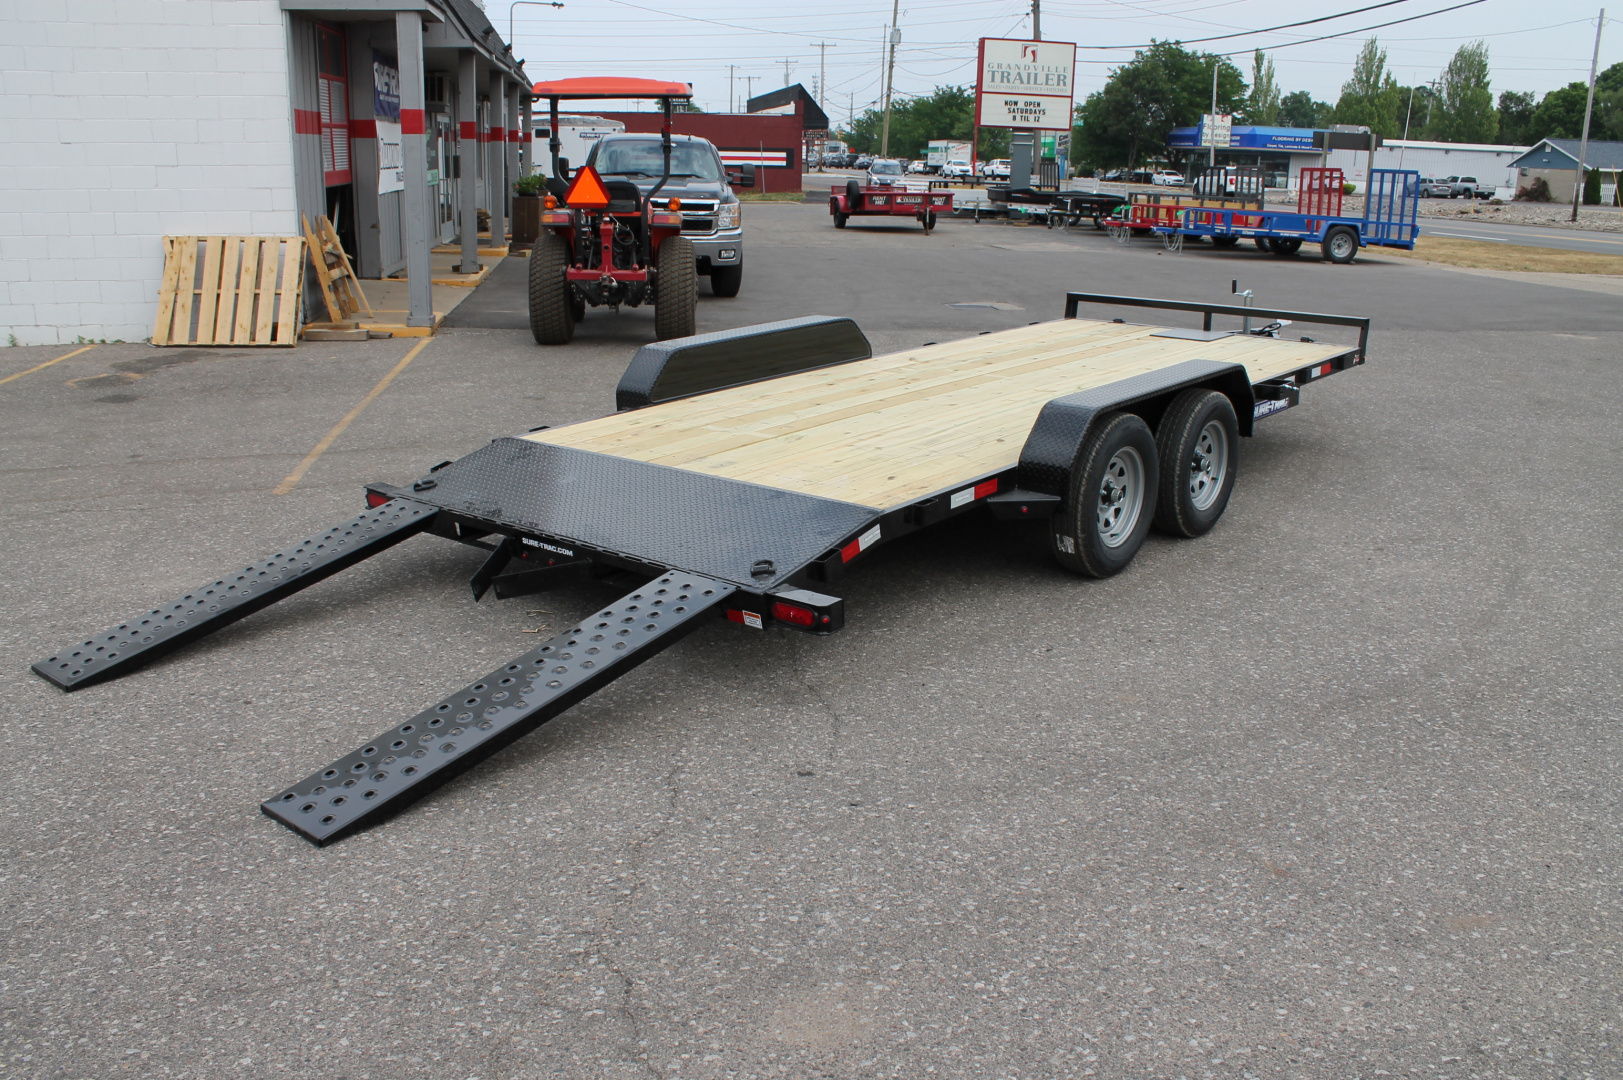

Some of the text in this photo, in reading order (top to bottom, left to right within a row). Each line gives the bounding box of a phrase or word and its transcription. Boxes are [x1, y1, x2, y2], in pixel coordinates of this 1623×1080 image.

[987, 62, 1069, 73] GRANDVILLE
[987, 70, 1067, 87] TRAILER
[1024, 100, 1041, 108] OPEN
[1007, 107, 1046, 115] SATURDAYS
[522, 537, 573, 556] SURE-TRAC.COM
